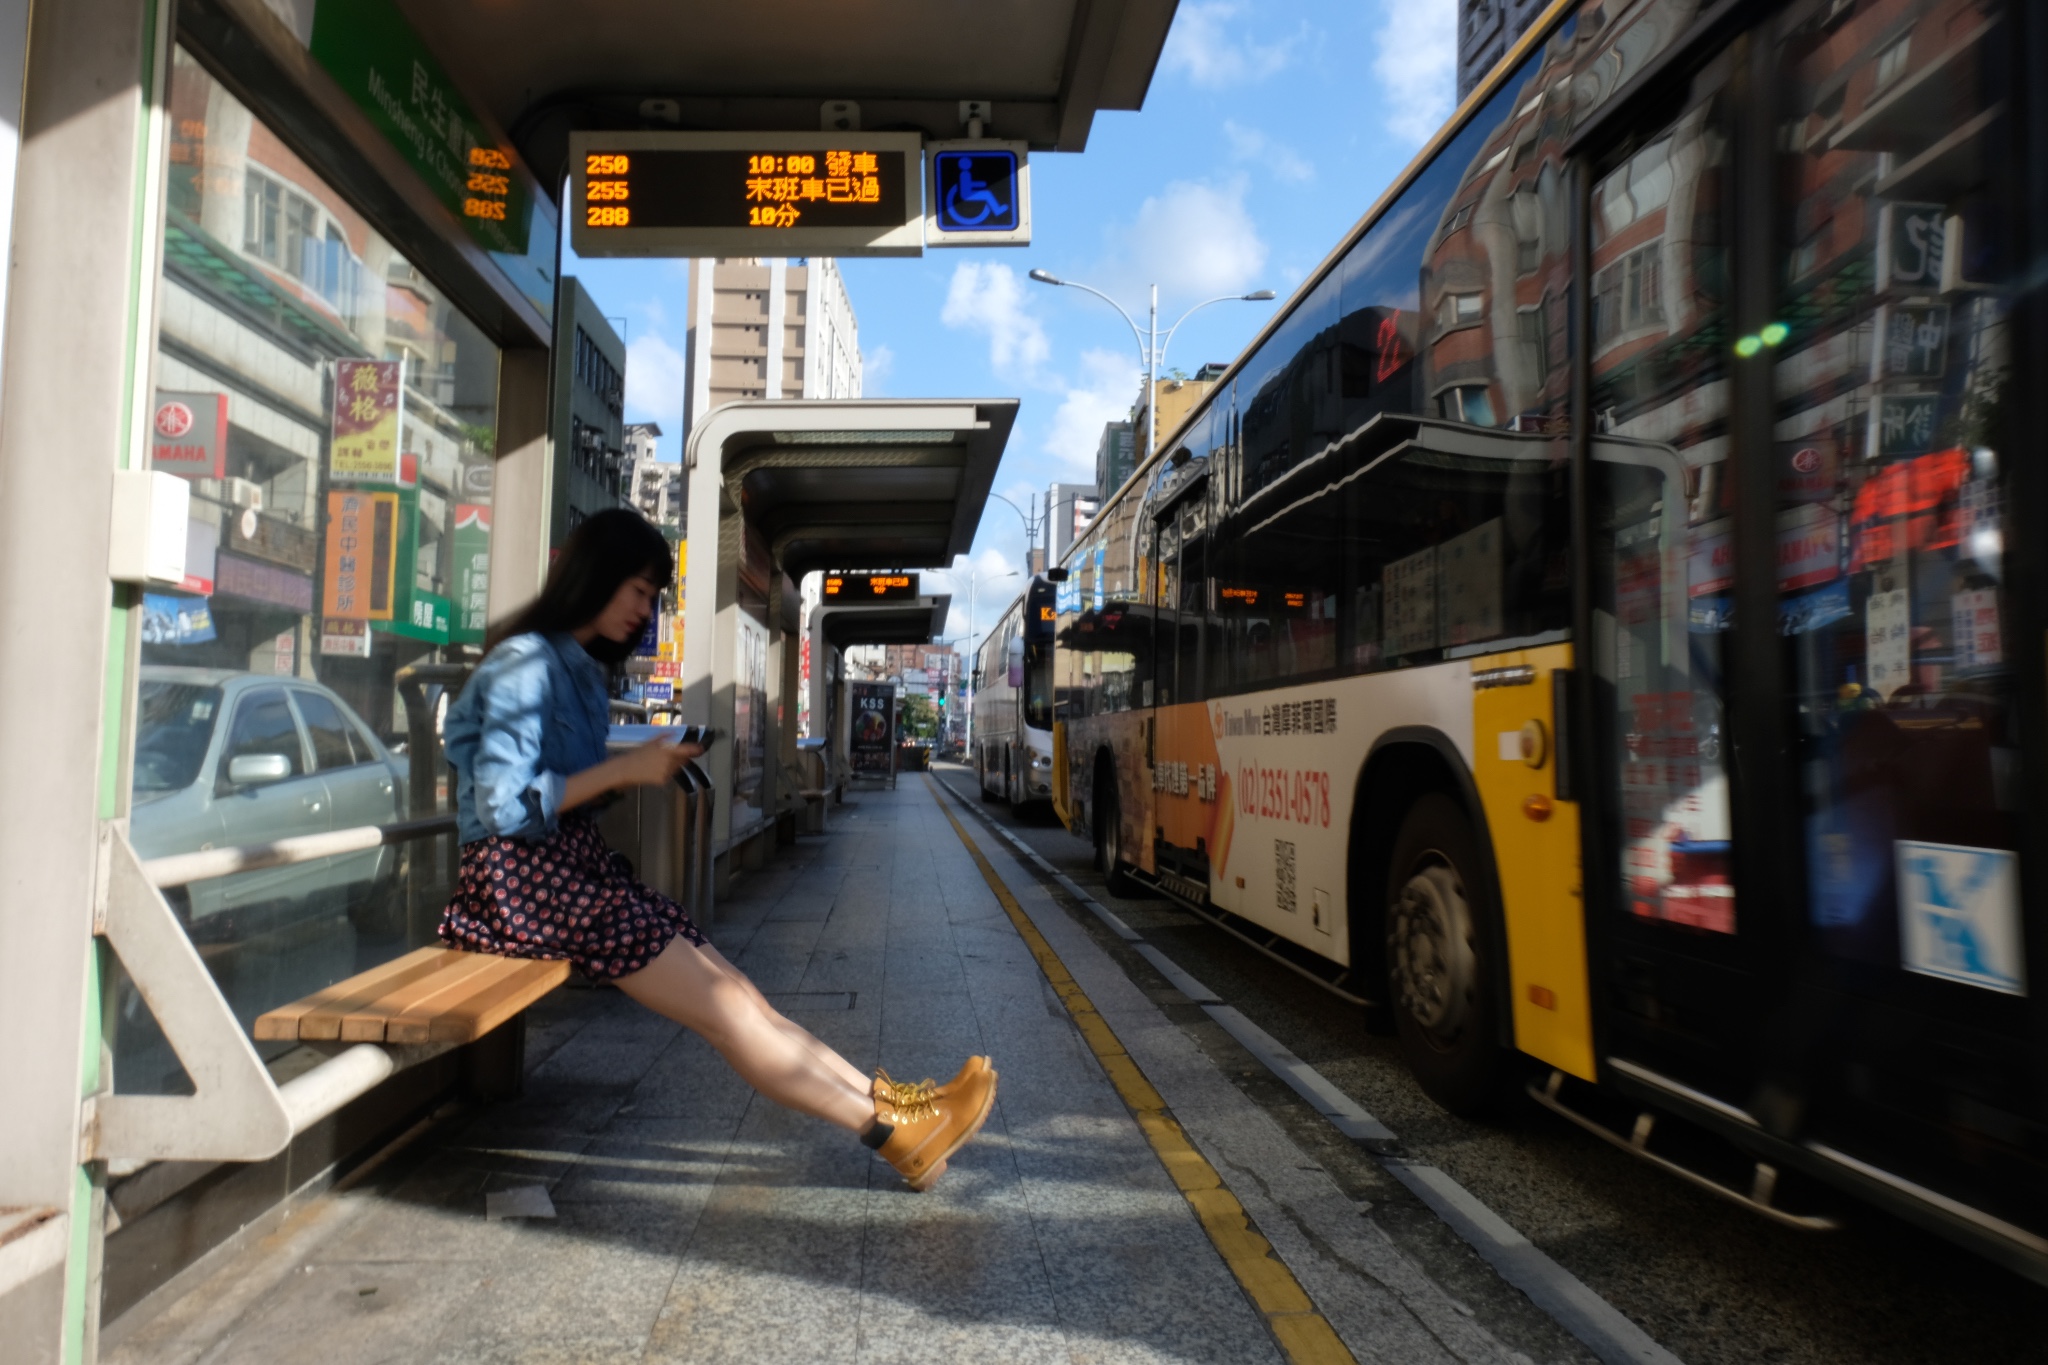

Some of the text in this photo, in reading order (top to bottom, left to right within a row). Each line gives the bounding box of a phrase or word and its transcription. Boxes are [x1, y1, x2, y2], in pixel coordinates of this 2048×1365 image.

[586, 155, 630, 175] 250
[748, 151, 878, 176] 10:00 發車
[586, 181, 630, 200] 255
[745, 176, 880, 202] 末班車已過
[586, 206, 630, 226] 288
[749, 202, 801, 227] 10分
[860, 697, 884, 710] KSS
